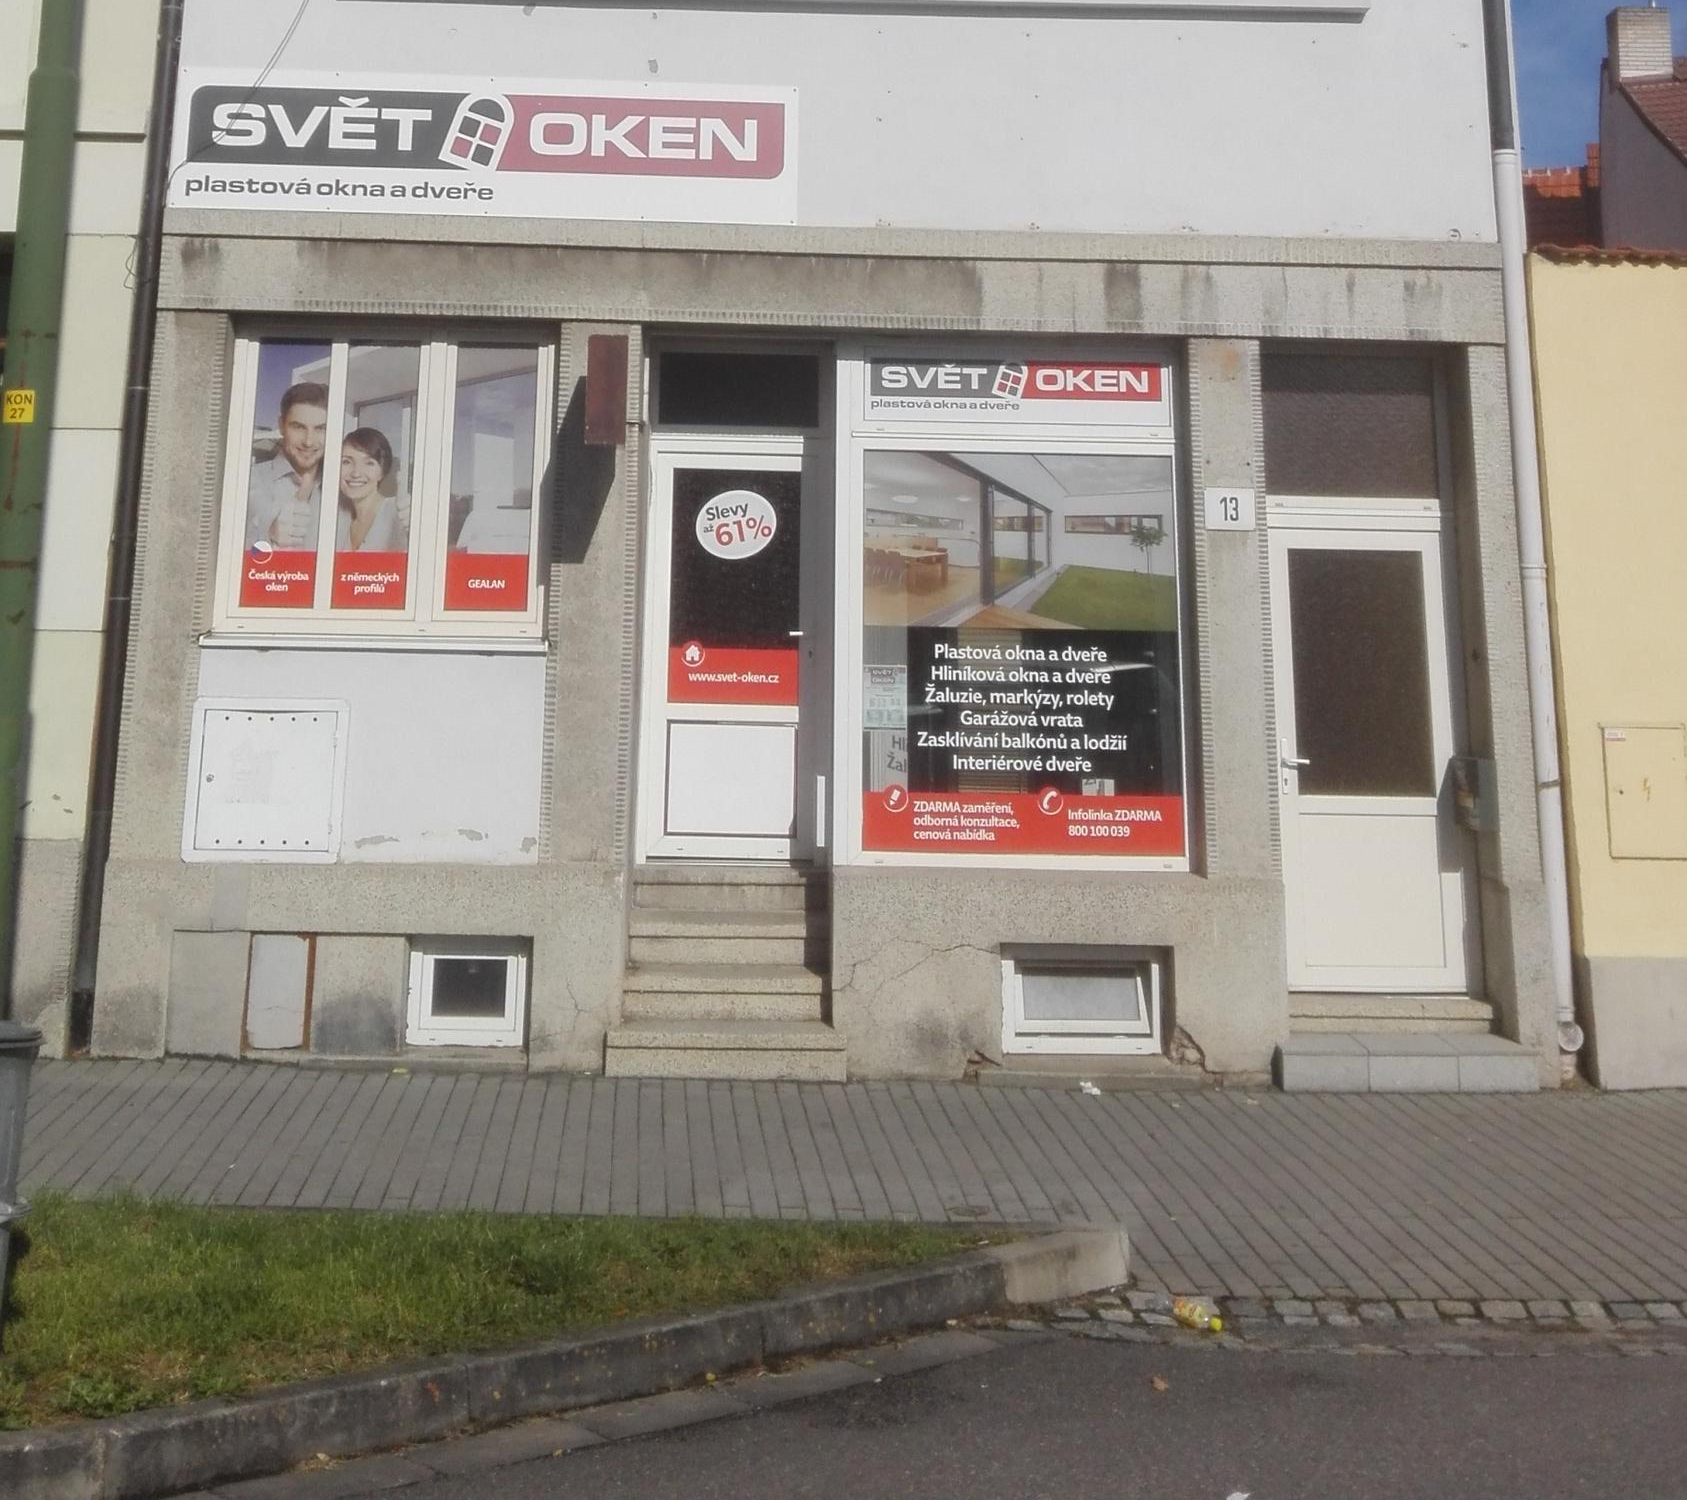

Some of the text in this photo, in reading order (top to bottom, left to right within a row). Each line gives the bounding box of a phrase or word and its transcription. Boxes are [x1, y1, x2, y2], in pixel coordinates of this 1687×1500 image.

[211, 95, 759, 161] SVĚT OKEN
[184, 175, 494, 201] plastová okna a dveře
[881, 363, 1149, 393] SVĚT OKEN
[6, 393, 33, 405] KON
[870, 398, 1020, 411] plastová okna a dveře
[9, 407, 25, 419] 27
[705, 502, 748, 521] Slevy
[1219, 496, 1239, 521] 13
[703, 515, 772, 546] až 61%
[248, 570, 309, 582] Česká výroba
[347, 572, 399, 583] německých
[265, 582, 289, 592] oken
[354, 584, 385, 595] profilů
[468, 579, 506, 589] GEALAN
[934, 643, 1107, 662] Plastová okna a dveře
[688, 671, 780, 683] www.svet-oken.cz
[931, 665, 1005, 682] Hliníková
[1008, 667, 1049, 683] okna
[1052, 672, 1062, 683] a
[925, 683, 987, 706] Žaluzie,
[990, 688, 1063, 709] markýzy,
[1066, 690, 1114, 711] rolety
[960, 709, 1083, 728] Garážová vrata
[917, 731, 1127, 751] Zasklívání balkónů a lodžií
[953, 754, 1092, 772] Interiérové dveře
[913, 801, 1014, 815] ZDARMA zaměření,
[913, 814, 1020, 829] odborná konzultace,
[1068, 809, 1162, 822] Infolinka ZDARMA
[913, 828, 995, 841] cenová nabídka
[1068, 825, 1130, 837] 800 100 039
